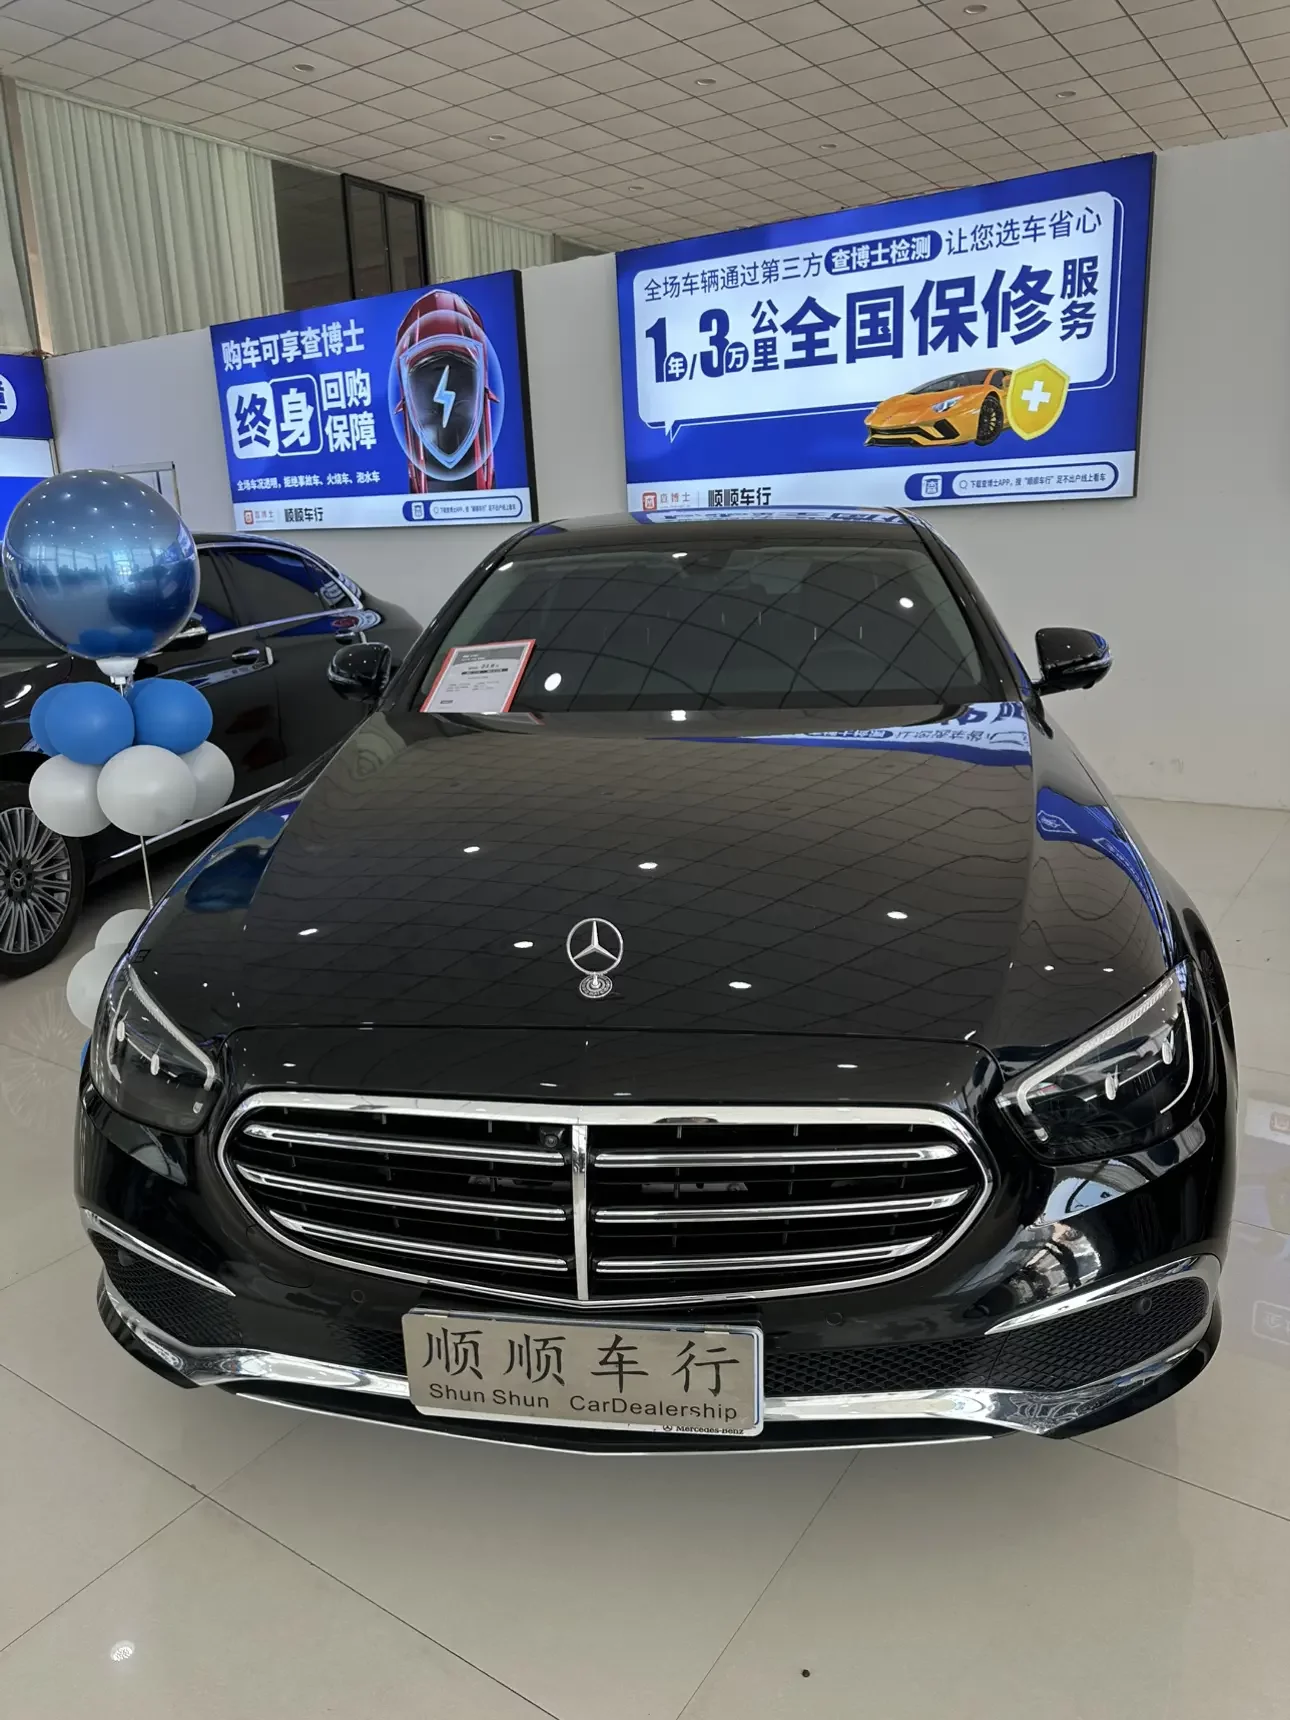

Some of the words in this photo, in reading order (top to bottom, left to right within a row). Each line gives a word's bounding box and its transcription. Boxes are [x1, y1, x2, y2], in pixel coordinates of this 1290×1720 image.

[644, 252, 823, 302] 全场车辆通过第三方
[831, 234, 931, 273] 查博士检测
[945, 206, 1102, 255] 让您选车省心
[751, 299, 779, 373] 公里
[780, 264, 1055, 370] 全国保修
[1059, 255, 1099, 341] 服务
[221, 319, 365, 372] 购车可享查博士
[319, 368, 372, 411] 回购
[235, 388, 314, 449] 终身
[324, 411, 377, 453] 保障
[708, 487, 772, 507] 顺顺车行
[422, 1327, 740, 1397] 顺顺车行
[429, 1383, 485, 1403] Shun
[493, 1389, 549, 1409] Shun
[570, 1395, 738, 1423] CarDealership
